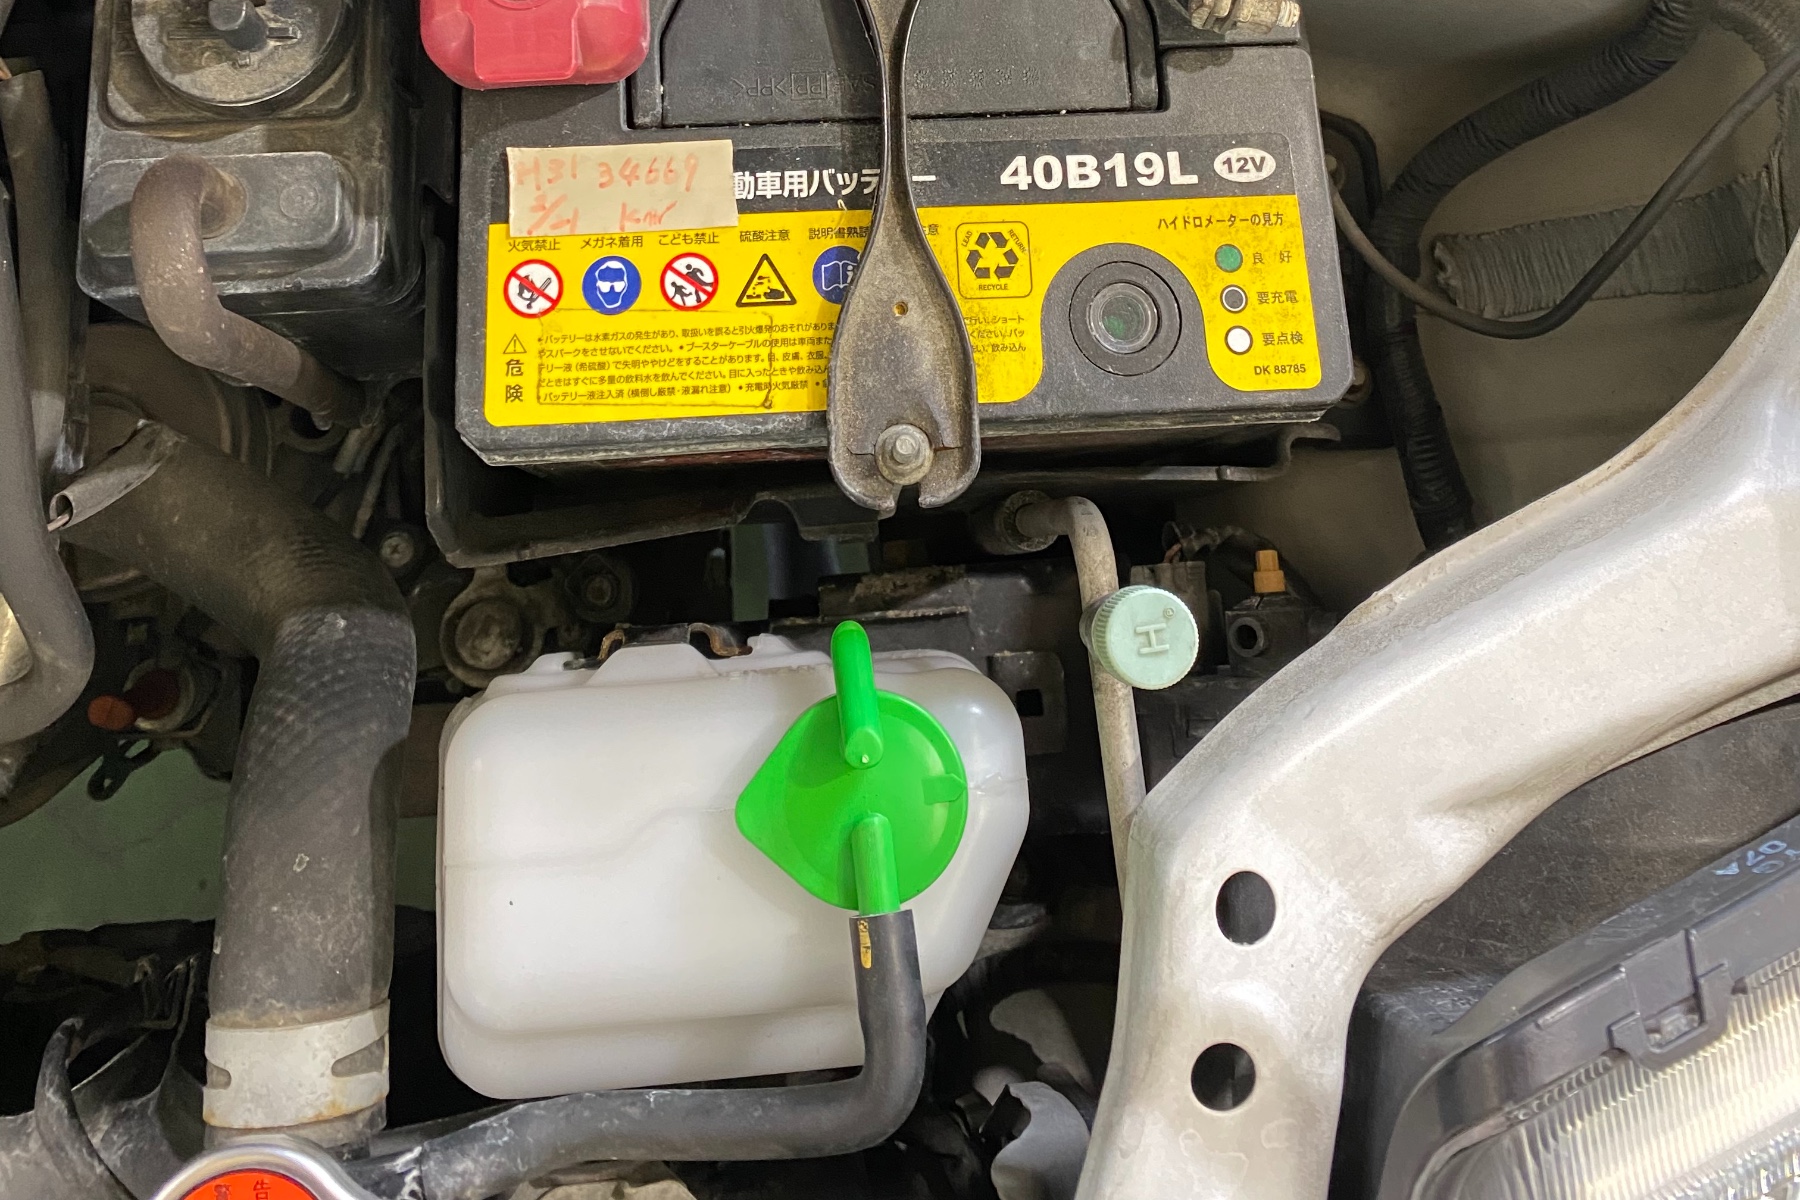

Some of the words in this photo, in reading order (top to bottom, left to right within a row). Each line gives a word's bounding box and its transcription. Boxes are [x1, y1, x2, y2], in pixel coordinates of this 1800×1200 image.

[598, 153, 699, 192] 34669
[1000, 150, 1199, 191] 40B19L
[1221, 156, 1267, 175] 12V
[1157, 212, 1284, 230] ハイドロメーターの見方
[580, 235, 644, 250] メガネ着用
[658, 232, 720, 246] こども禁止
[739, 229, 790, 243] 硫酸注意
[961, 230, 973, 247] LEAD
[1008, 229, 1027, 254] RETURN
[507, 238, 561, 253] 火気禁止
[978, 283, 1009, 291] RECYCLE
[1256, 290, 1299, 305] 要充電
[1262, 331, 1304, 346] 要点検
[1254, 365, 1270, 375] DK
[1274, 363, 1306, 374] 88785
